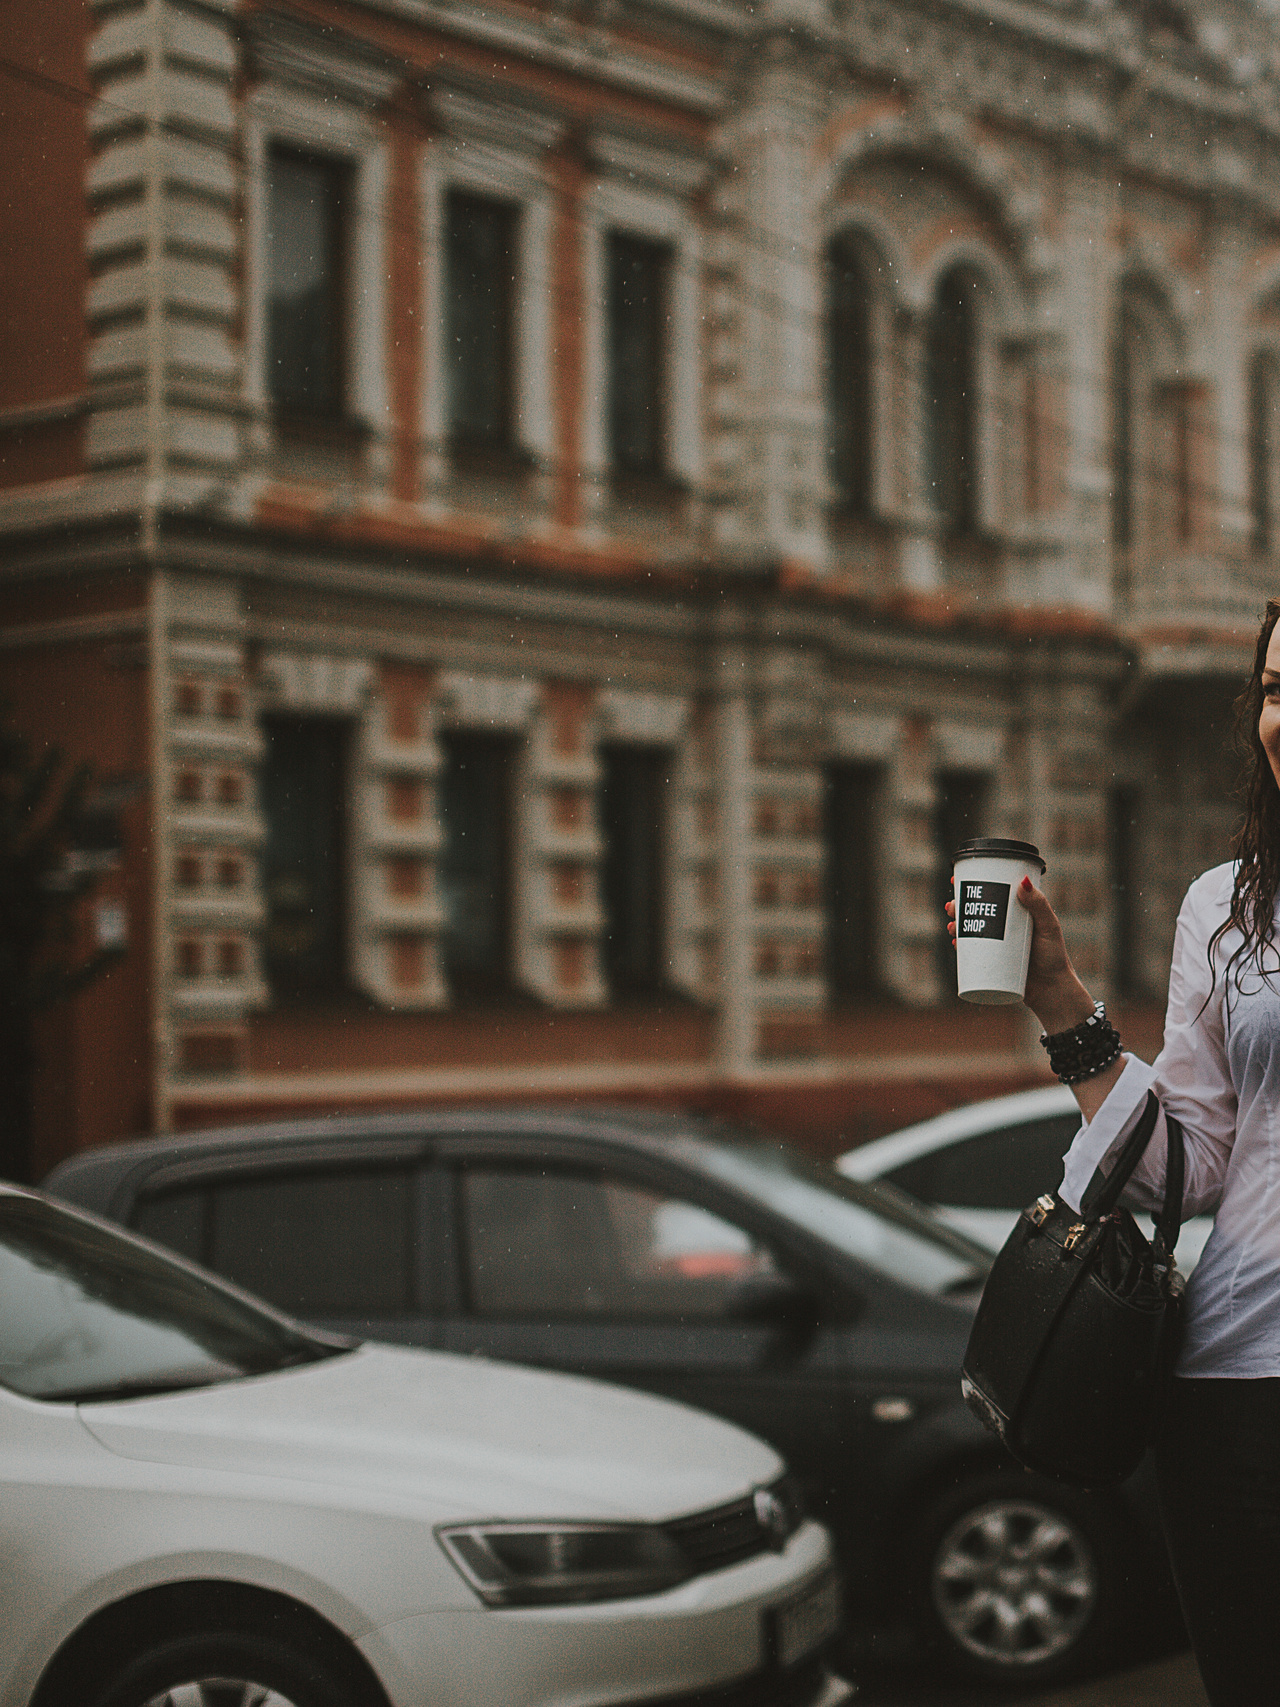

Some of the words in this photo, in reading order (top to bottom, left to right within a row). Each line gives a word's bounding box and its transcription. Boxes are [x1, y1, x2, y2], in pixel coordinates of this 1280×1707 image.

[966, 885, 983, 899] THE
[964, 902, 997, 917] COFFEE
[963, 919, 985, 932] SHOP
